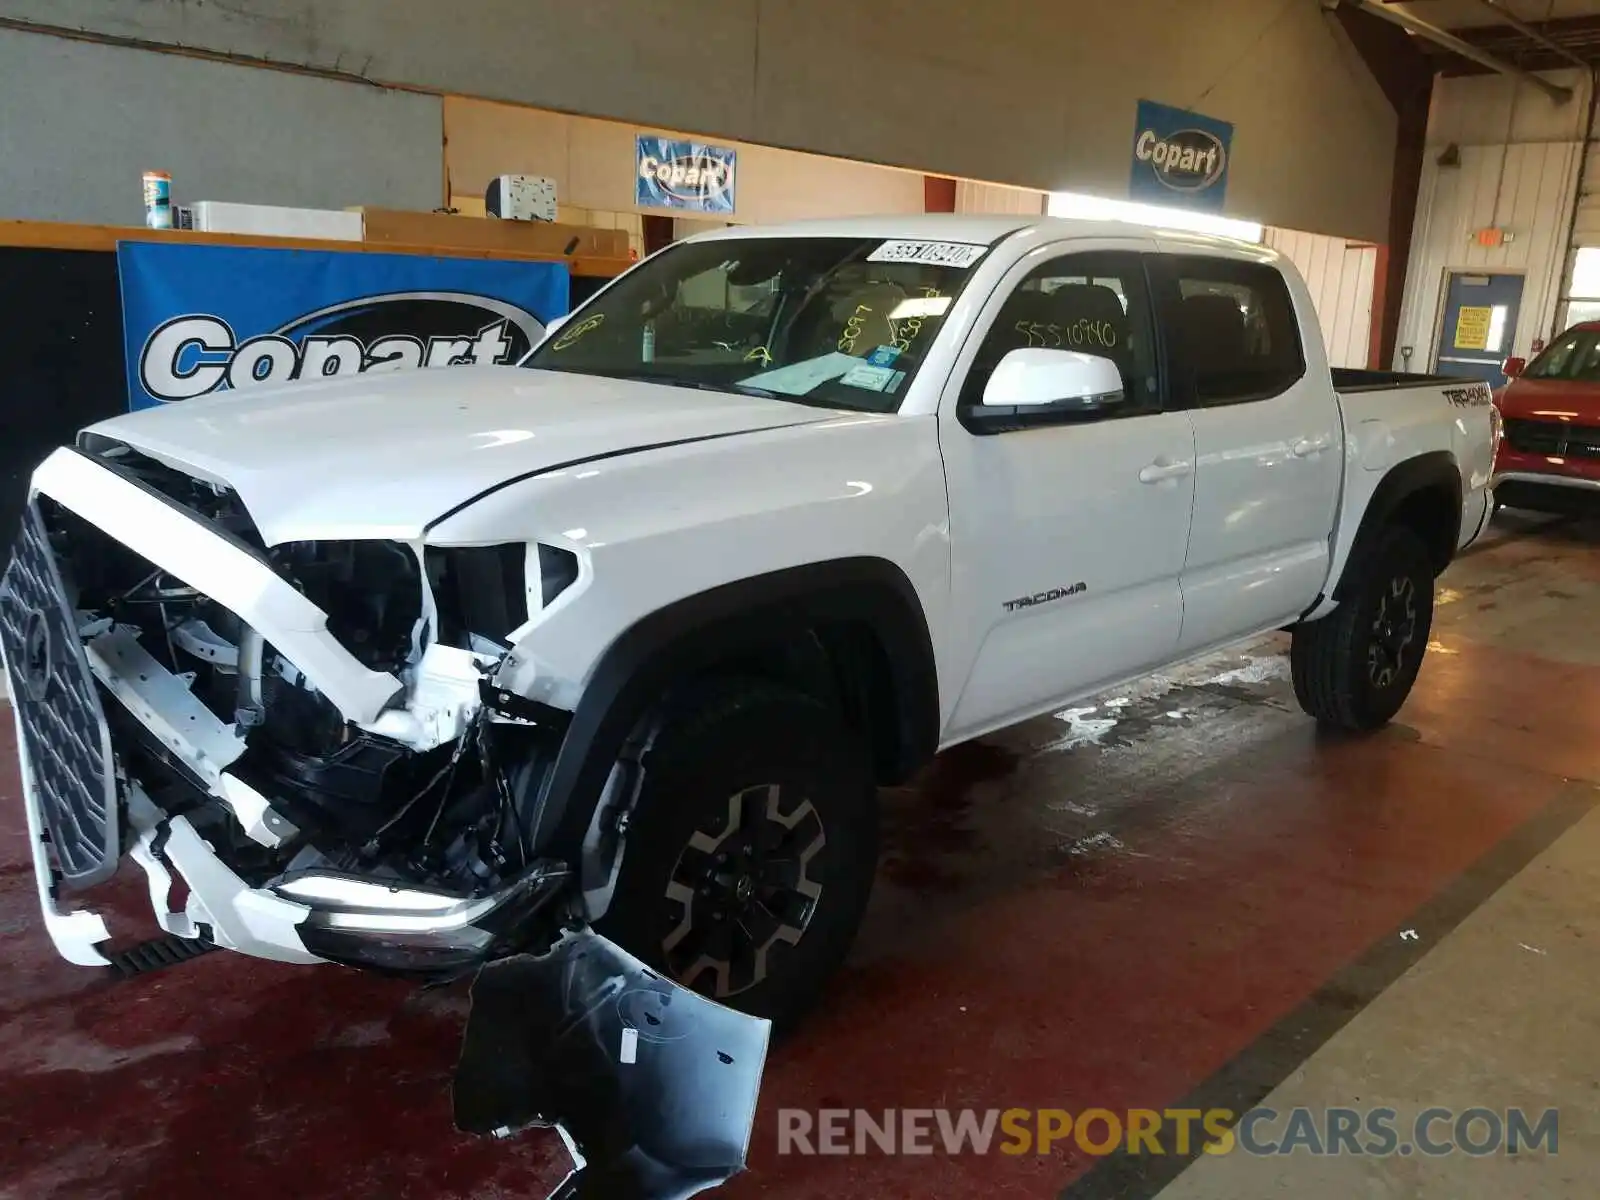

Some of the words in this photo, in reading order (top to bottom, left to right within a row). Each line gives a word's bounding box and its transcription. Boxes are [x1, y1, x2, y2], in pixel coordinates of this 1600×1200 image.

[1135, 130, 1217, 174] Copart
[639, 156, 722, 189] Copart
[1002, 582, 1087, 612] TACOMA
